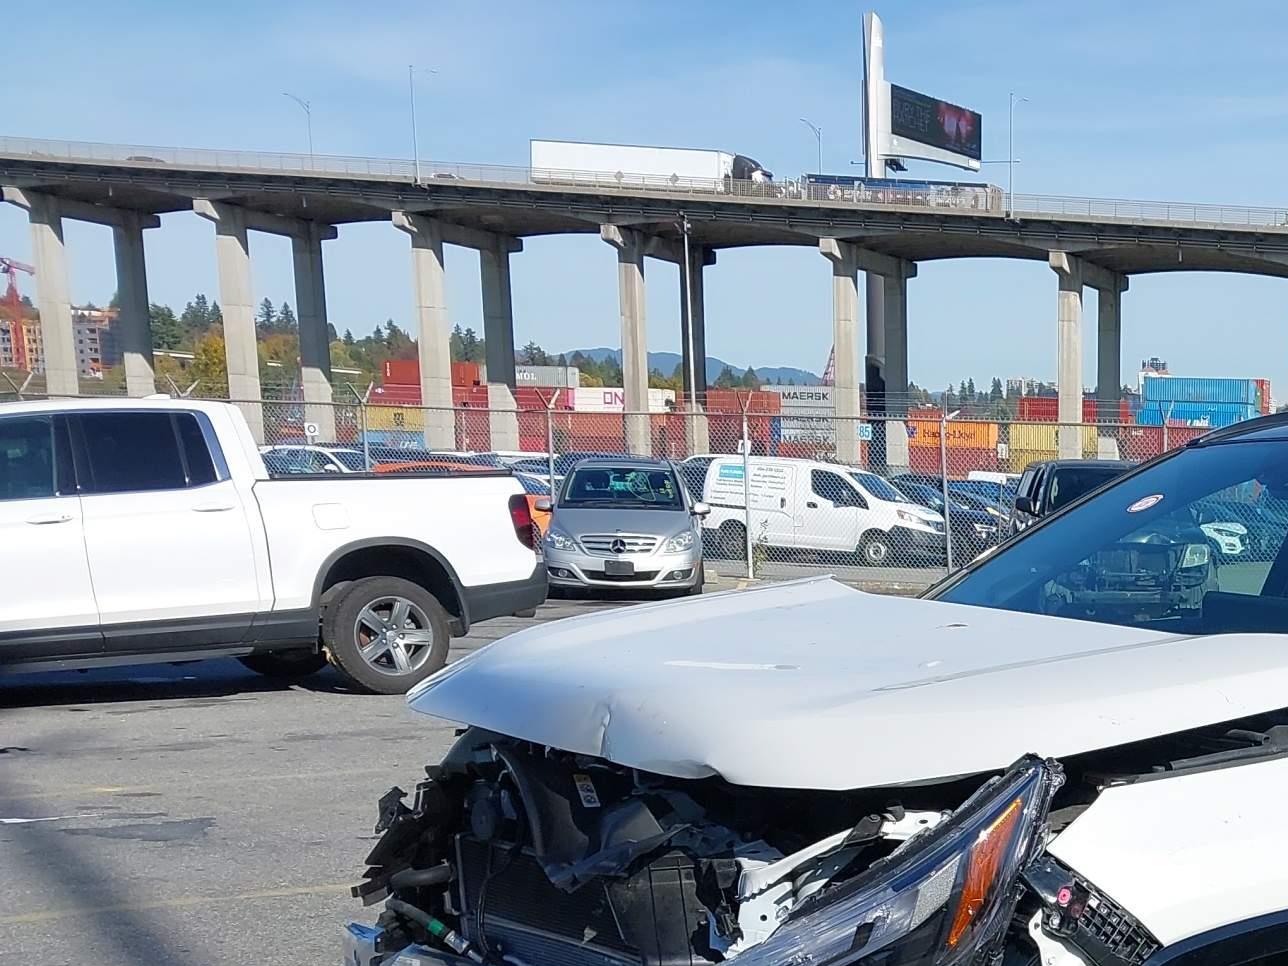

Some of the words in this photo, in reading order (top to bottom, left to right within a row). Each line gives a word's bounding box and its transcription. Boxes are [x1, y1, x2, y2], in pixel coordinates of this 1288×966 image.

[603, 391, 625, 405] ON
[782, 391, 829, 401] MAERSK
[859, 425, 871, 438] 85
